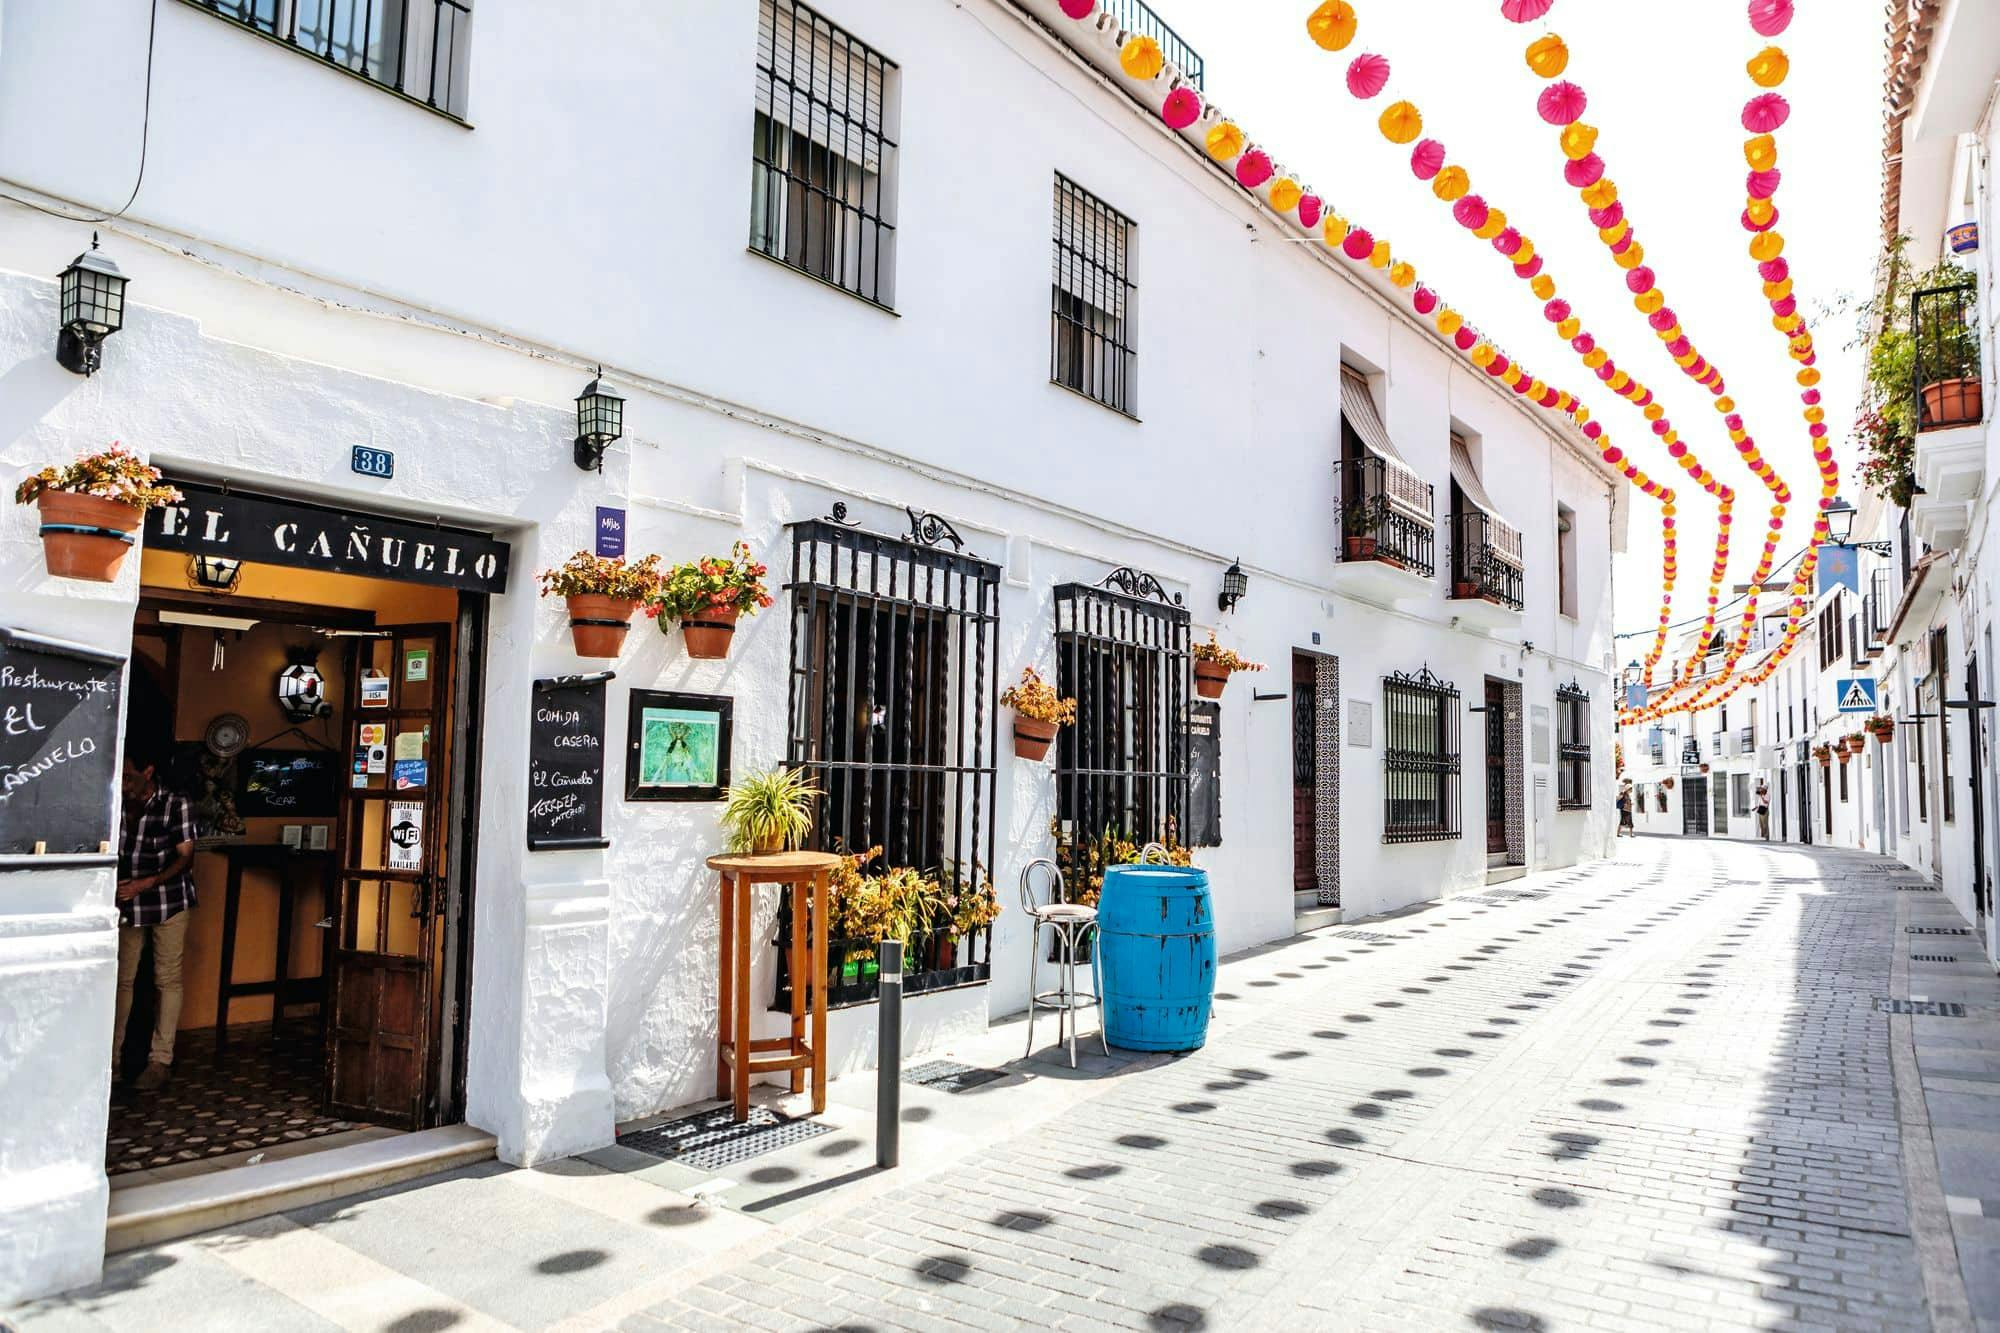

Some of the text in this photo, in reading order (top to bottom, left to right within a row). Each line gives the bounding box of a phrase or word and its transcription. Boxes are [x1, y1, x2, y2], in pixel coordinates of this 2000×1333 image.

[361, 452, 386, 474] 38
[161, 506, 497, 580] EL CAÑUELO
[553, 734, 599, 748] CASERA
